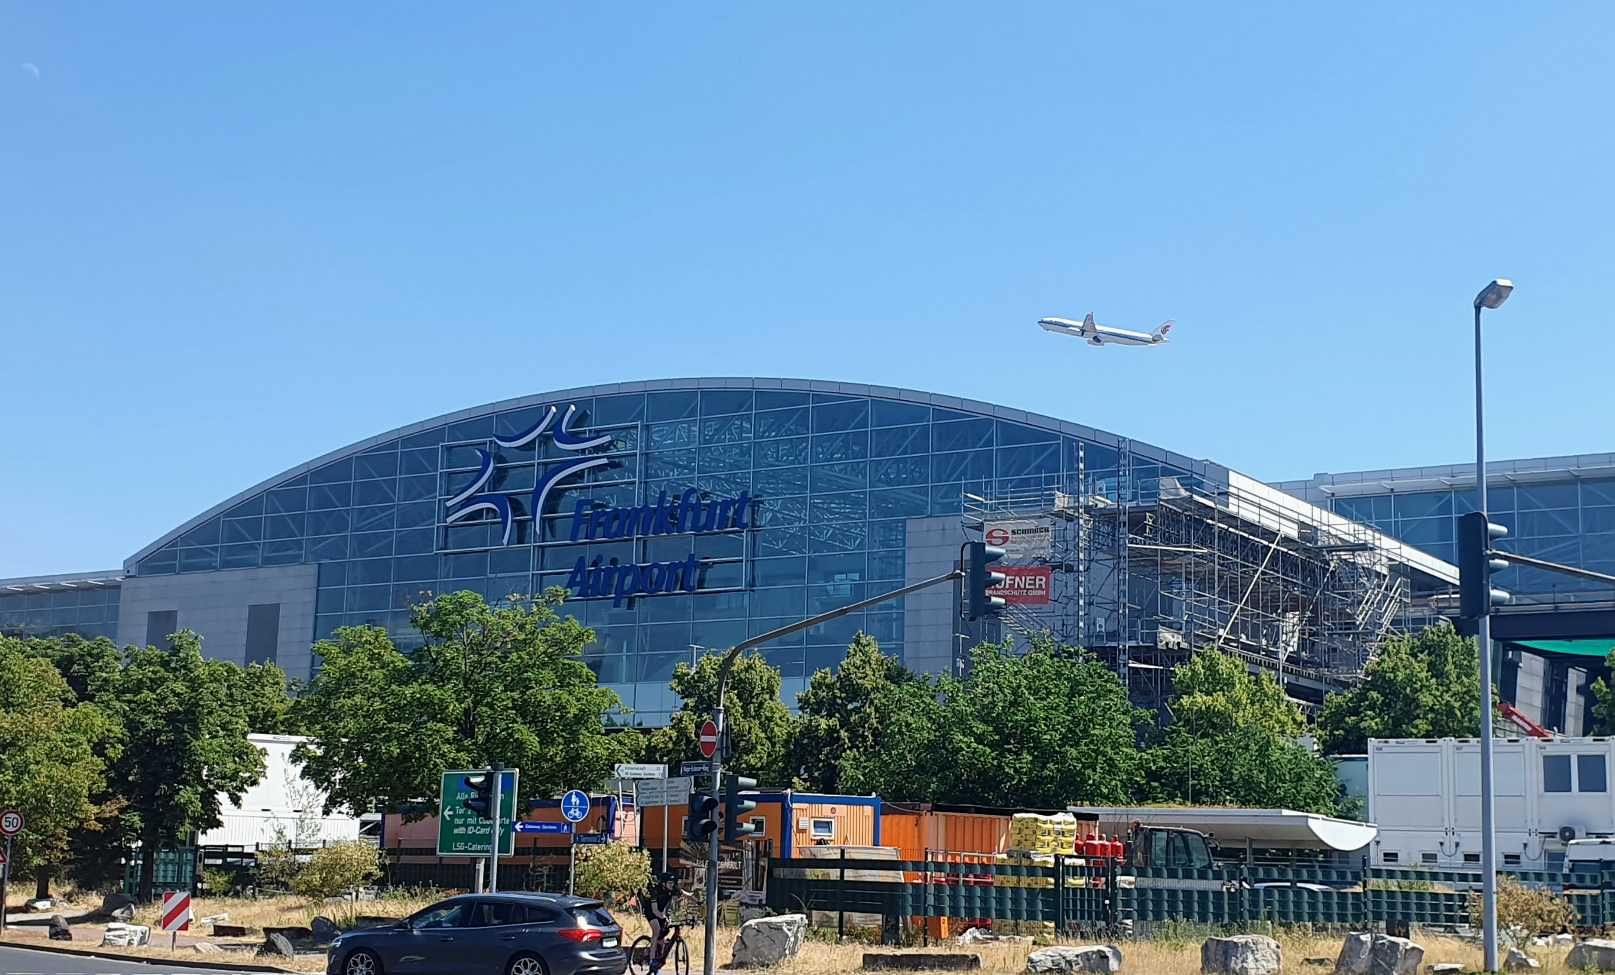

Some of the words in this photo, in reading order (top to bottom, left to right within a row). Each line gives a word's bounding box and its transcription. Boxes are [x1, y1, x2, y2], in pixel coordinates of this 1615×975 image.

[570, 487, 752, 541] Frankfurt
[566, 553, 699, 609] Airport
[456, 806, 465, 814] Tor
[5, 817, 18, 828] 50
[467, 826, 491, 834] ID-Card
